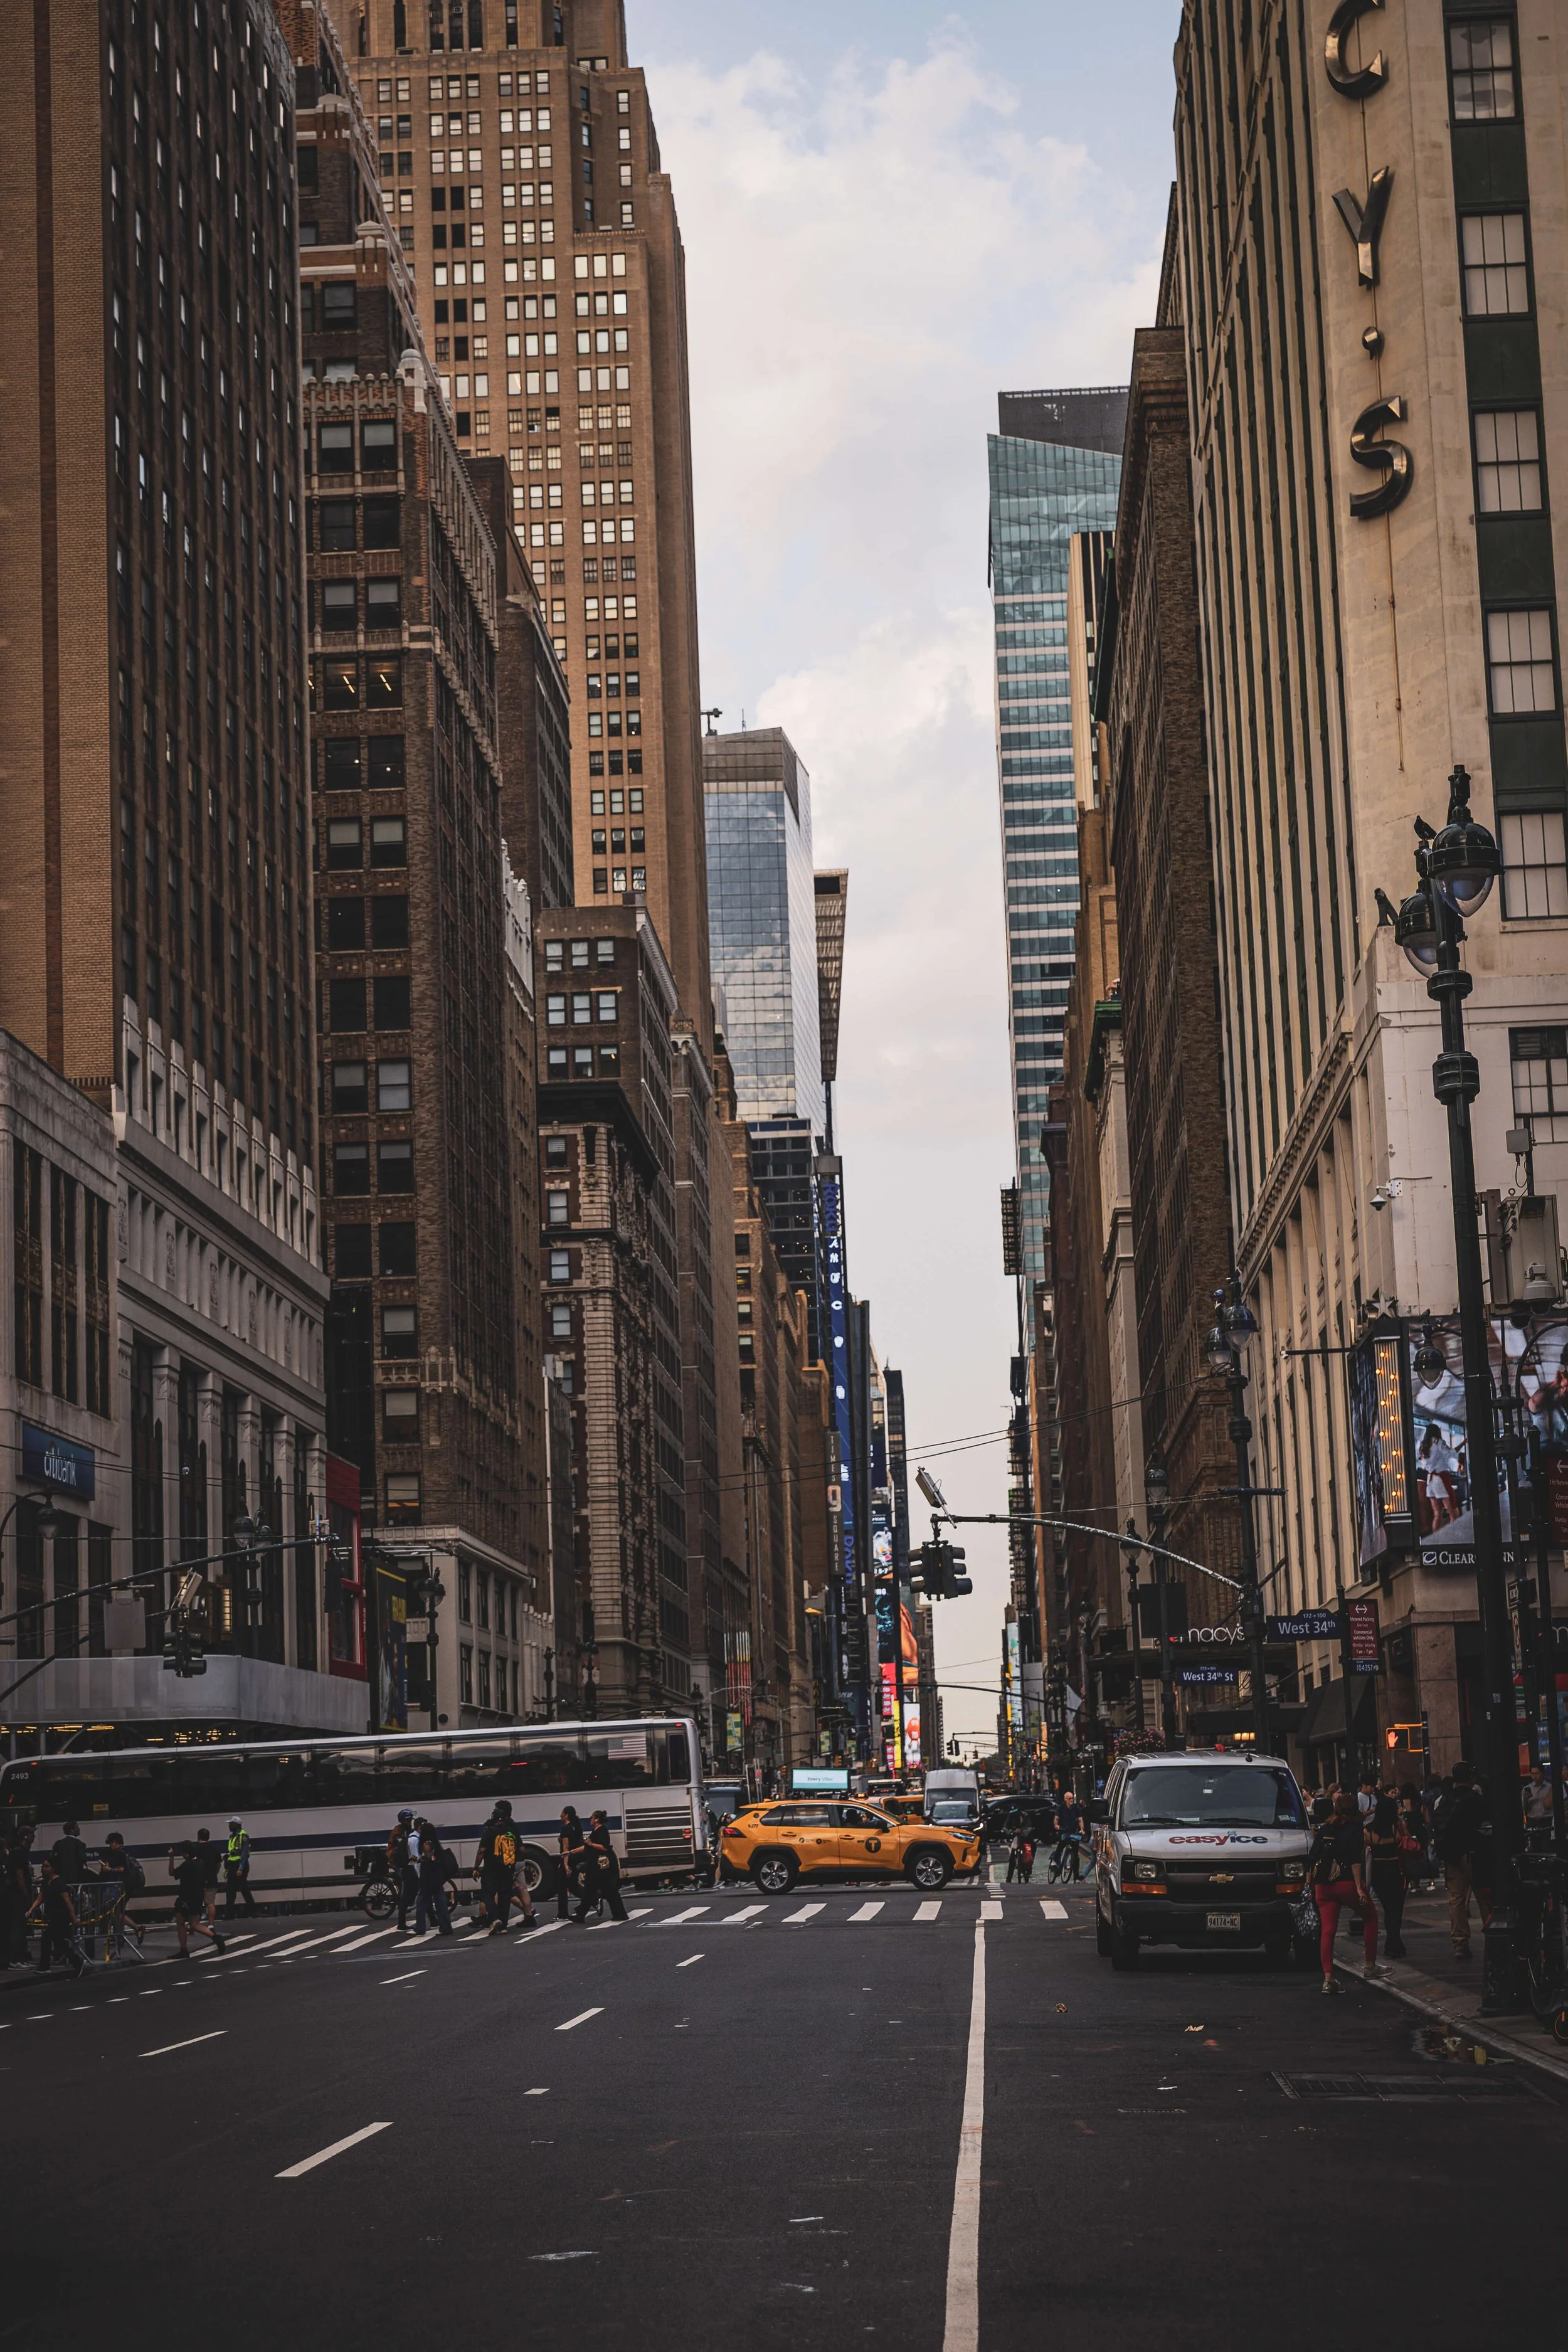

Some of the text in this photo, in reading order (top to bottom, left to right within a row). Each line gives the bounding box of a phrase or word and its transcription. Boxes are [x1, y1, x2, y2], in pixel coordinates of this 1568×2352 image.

[44, 1446, 77, 1486] citibank
[827, 1485, 842, 1512] 9
[1278, 1619, 1336, 1634] West 34th
[1183, 1671, 1234, 1682] West 34th St
[11, 1772, 29, 1780] 2493
